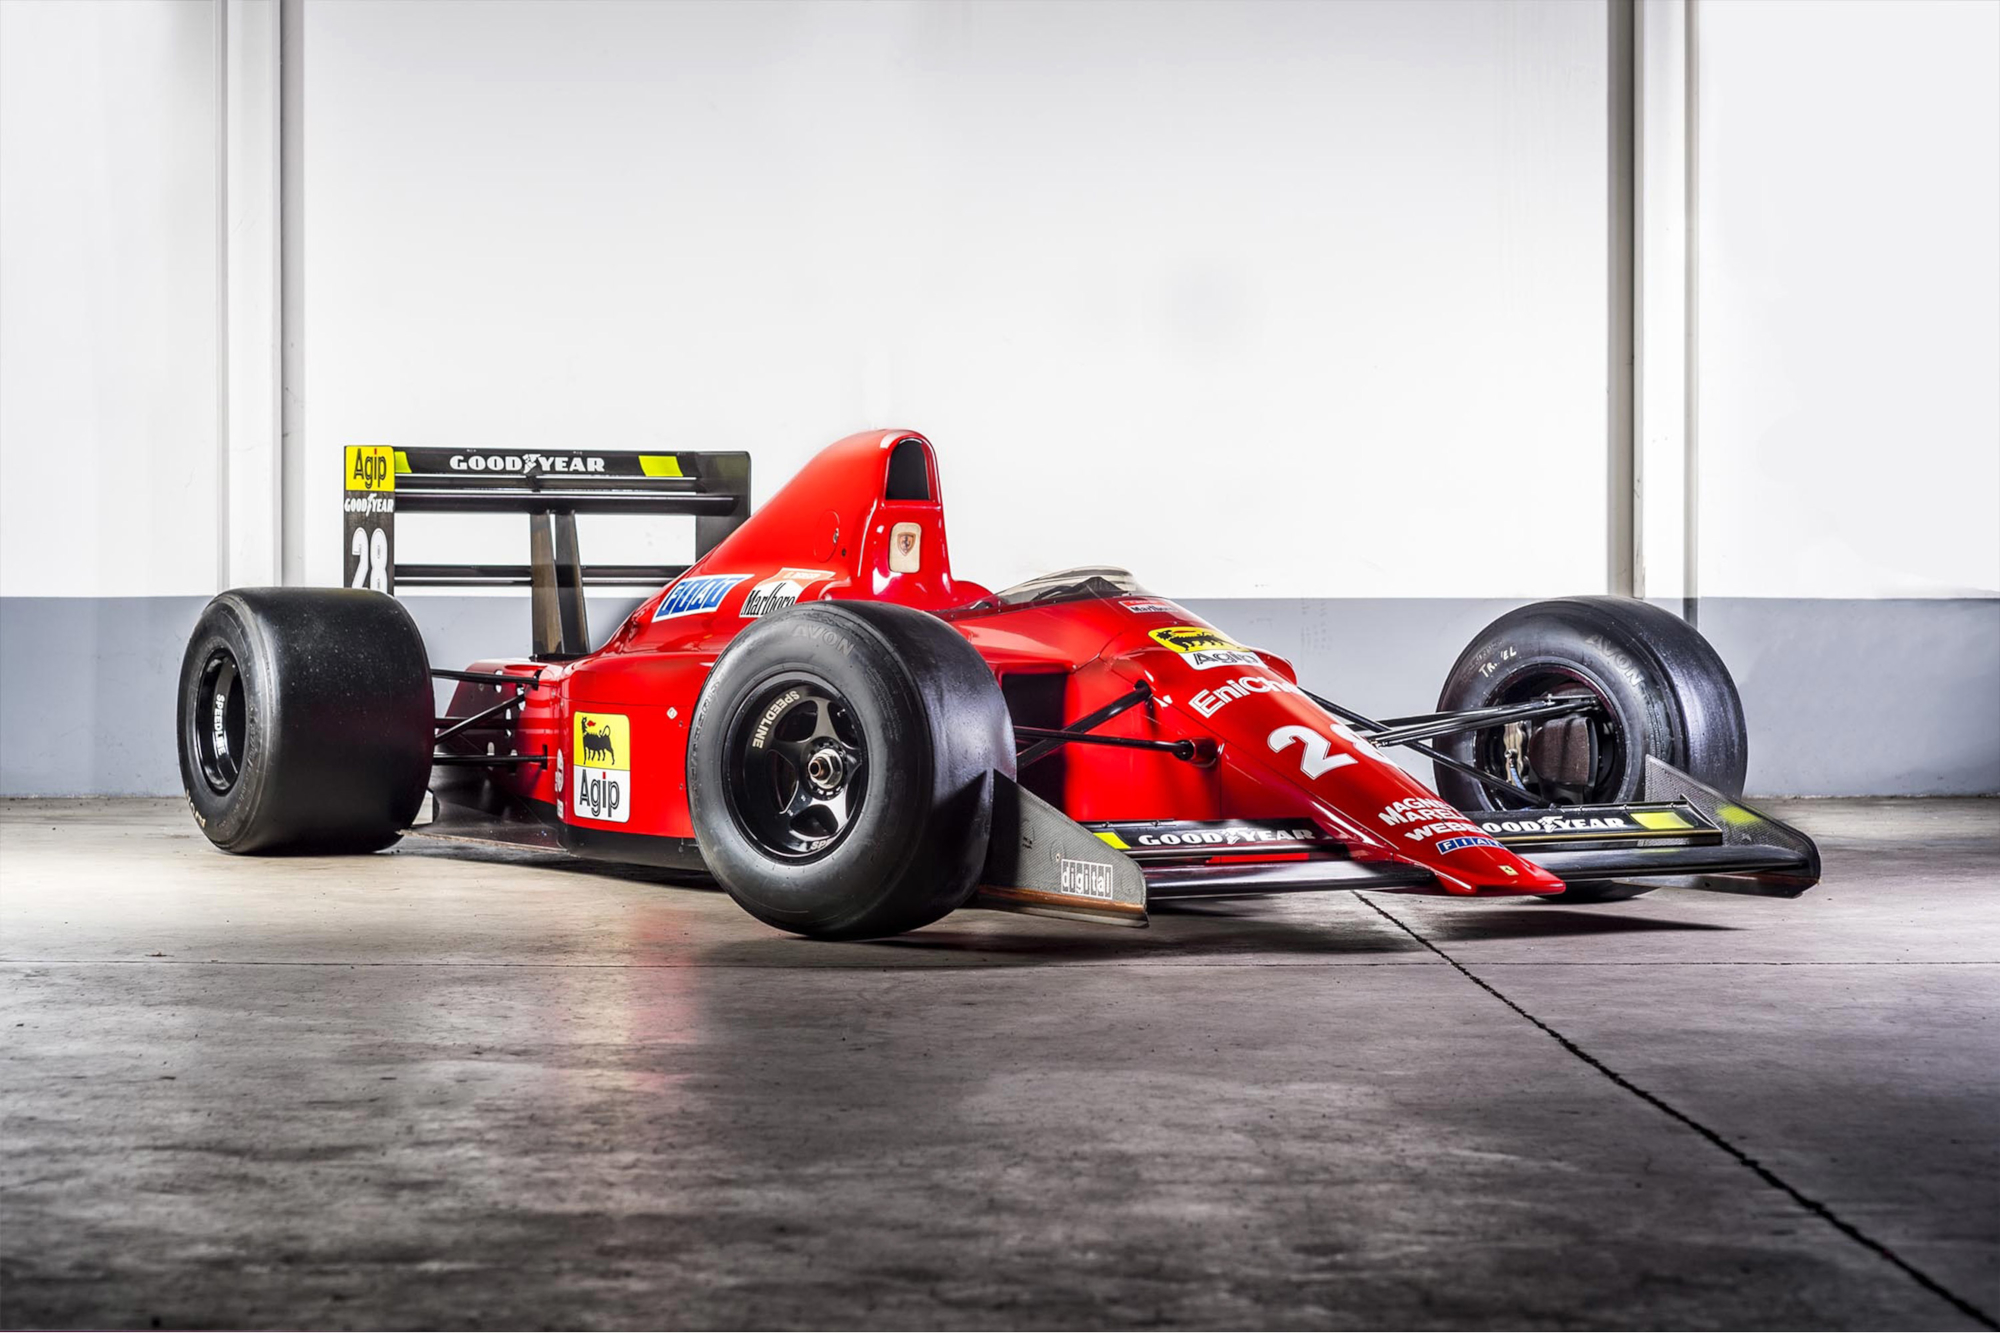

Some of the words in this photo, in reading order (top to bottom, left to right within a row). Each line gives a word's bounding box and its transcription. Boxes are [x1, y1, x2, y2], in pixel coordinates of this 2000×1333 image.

[353, 448, 387, 489] Agip
[450, 454, 606, 473] GOODYEAR
[344, 495, 395, 514] GOODYEAR
[352, 527, 388, 594] 28
[661, 577, 737, 612] FIAT
[741, 582, 796, 616] Marlboro
[792, 624, 855, 657] AVON
[1193, 651, 1259, 666] Agip
[1585, 635, 1645, 688] AVON
[752, 690, 801, 749] SPEEDLINE
[580, 769, 620, 817] Agip
[1138, 827, 1316, 846] GOODYEAR
[1404, 822, 1488, 841] WEBE
[1481, 816, 1627, 833] OODYEAR
[1062, 866, 1112, 894] digital
